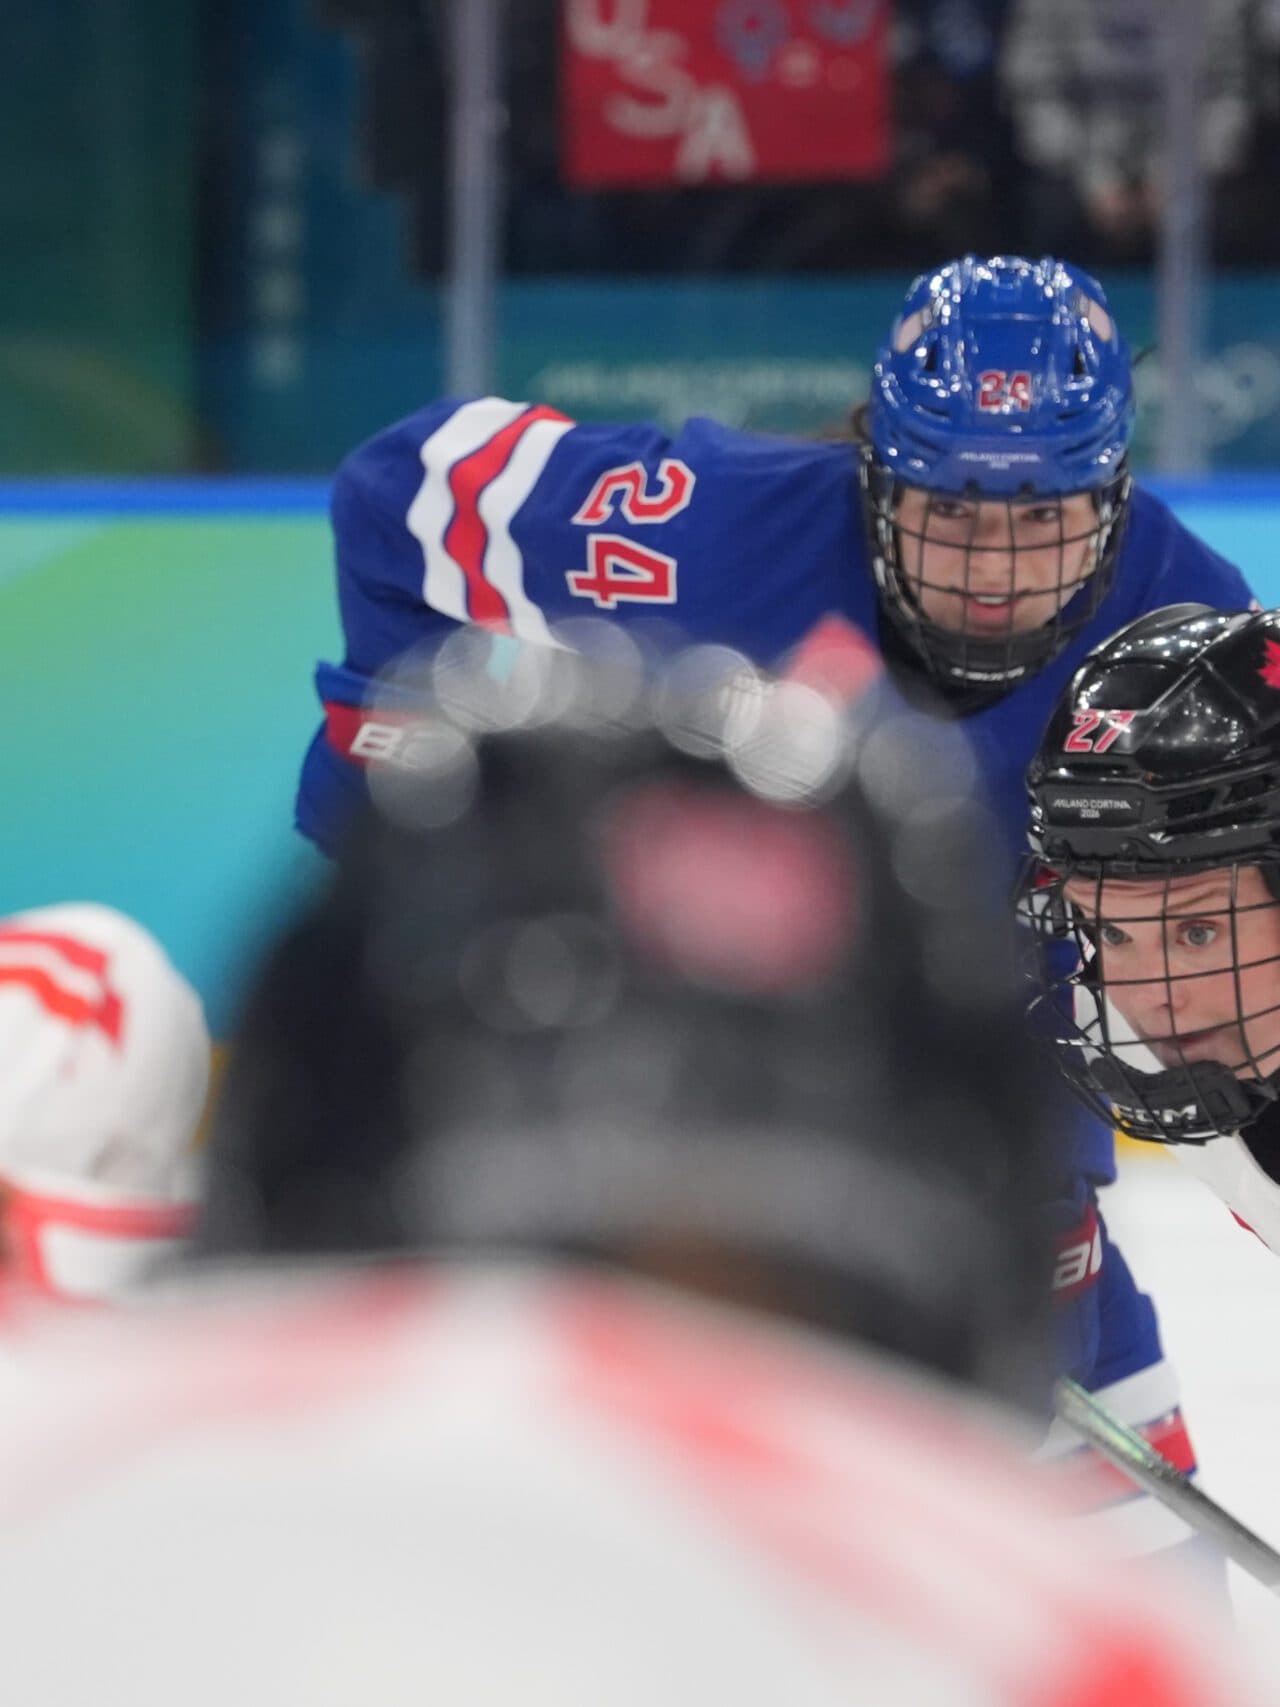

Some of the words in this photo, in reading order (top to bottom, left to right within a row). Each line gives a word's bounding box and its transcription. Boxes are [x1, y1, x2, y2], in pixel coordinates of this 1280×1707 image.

[978, 370, 1031, 411] 24
[565, 458, 697, 609] 24
[1064, 709, 1137, 753] 27
